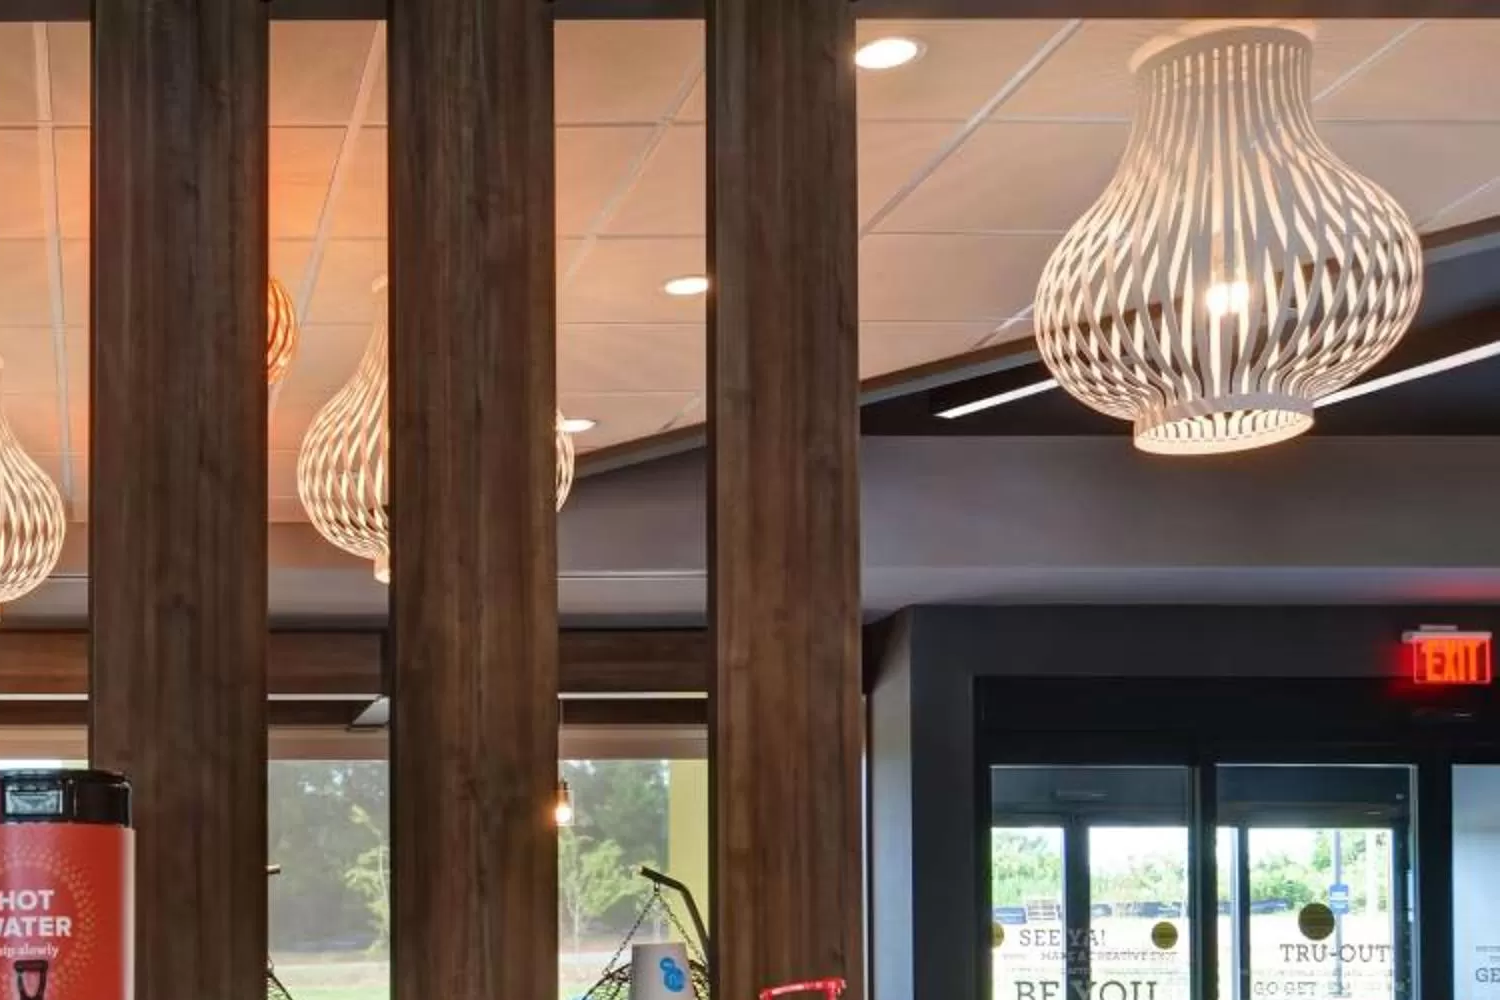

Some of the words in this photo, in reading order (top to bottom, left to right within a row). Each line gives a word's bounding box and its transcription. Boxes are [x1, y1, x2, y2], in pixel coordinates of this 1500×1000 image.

[1422, 639, 1481, 682] EXIT
[1019, 929, 1061, 947] SEE
[1068, 928, 1106, 947] YA!
